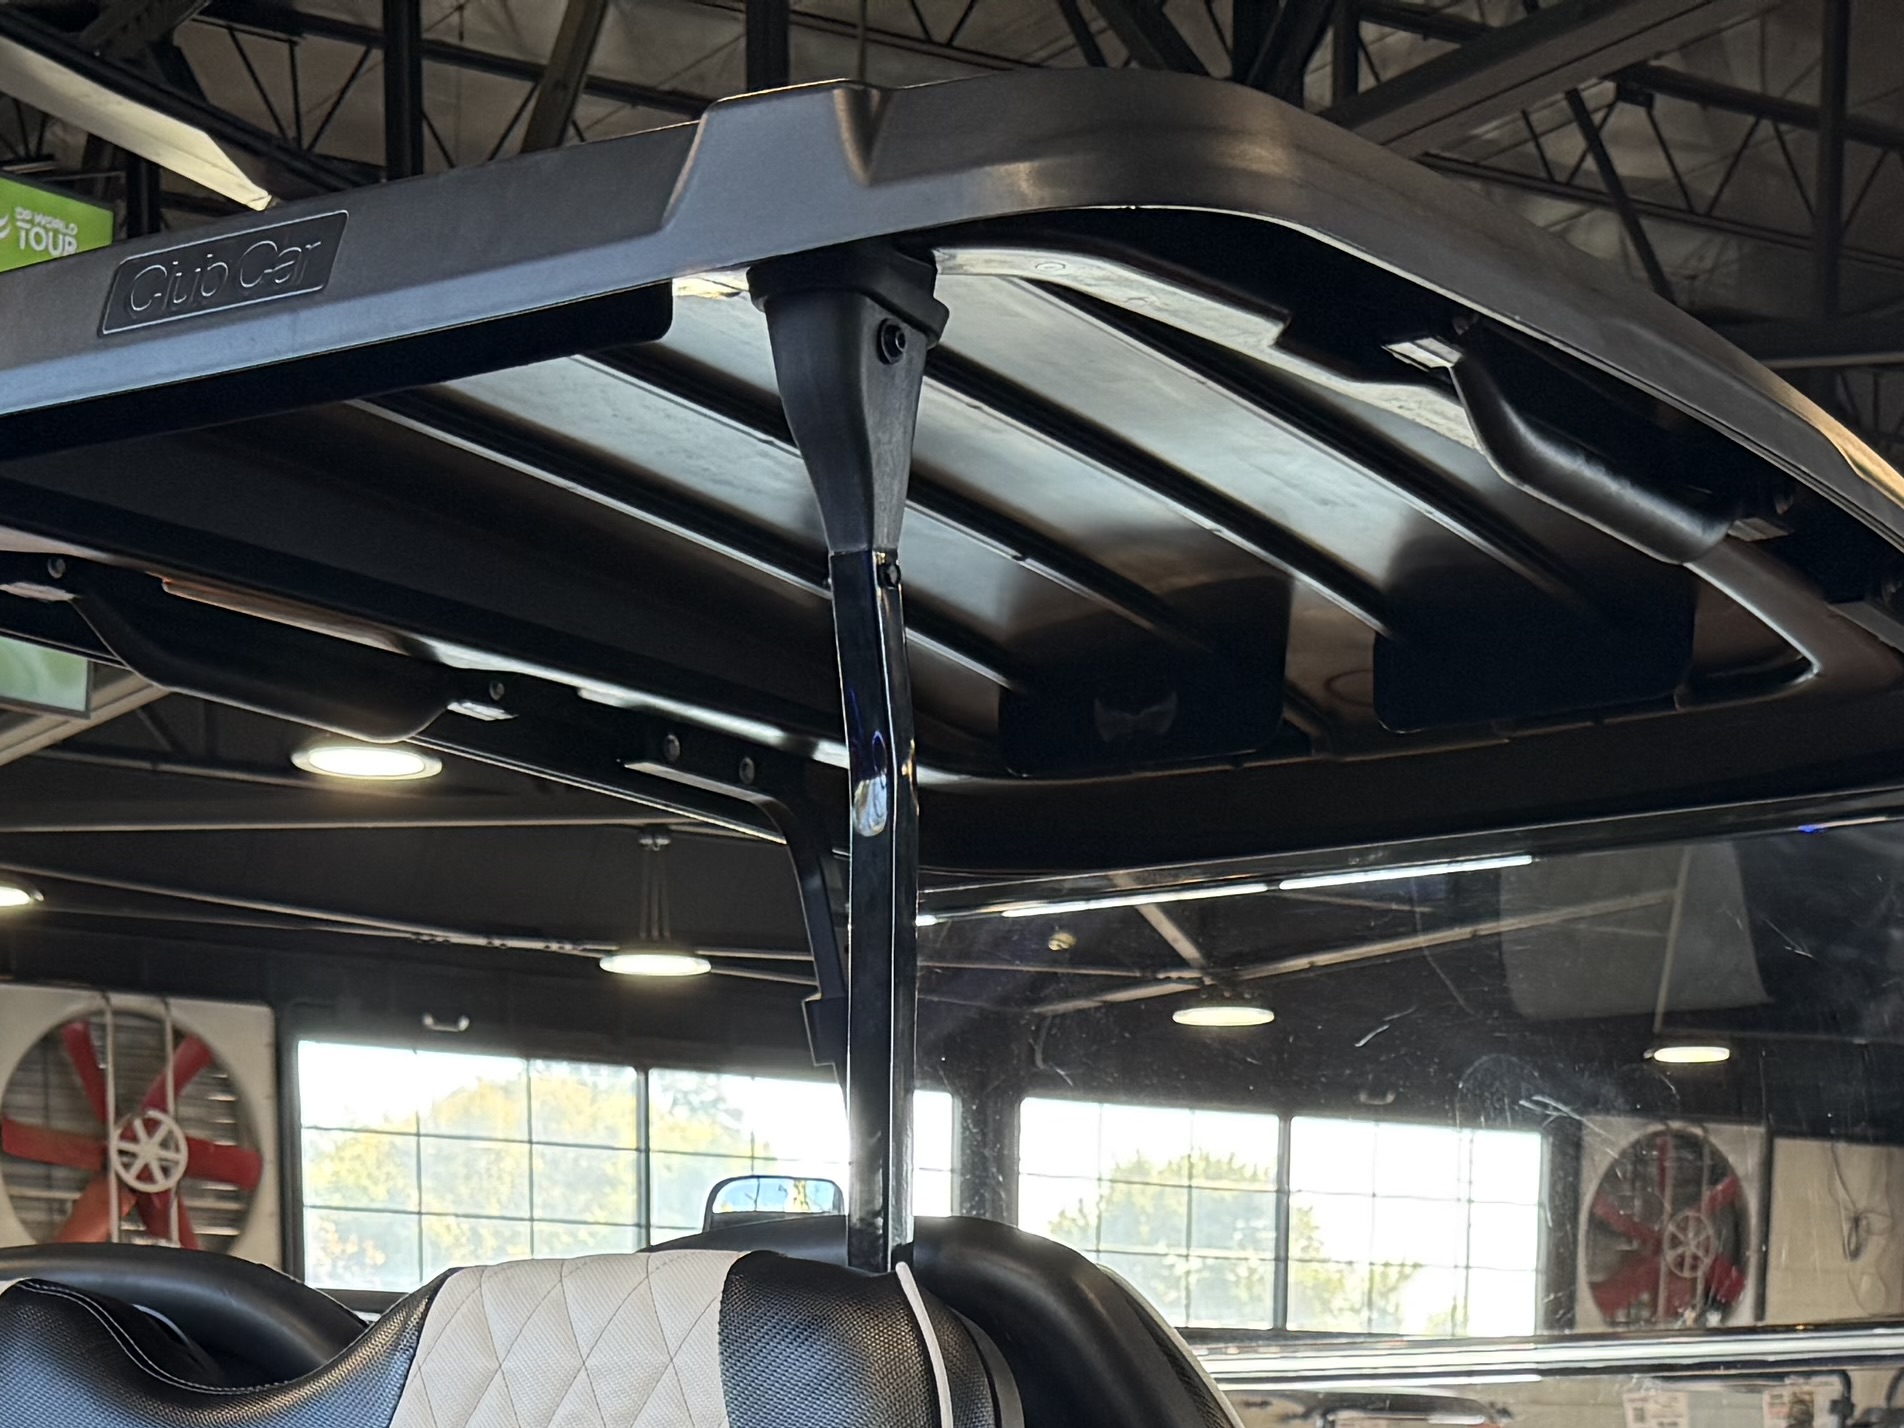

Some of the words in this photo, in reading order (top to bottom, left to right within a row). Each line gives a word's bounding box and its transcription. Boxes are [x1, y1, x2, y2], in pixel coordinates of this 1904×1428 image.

[34, 212, 78, 236] WORLD
[16, 226, 78, 257] TOUR
[130, 253, 229, 312] Club
[239, 240, 322, 288] Car
